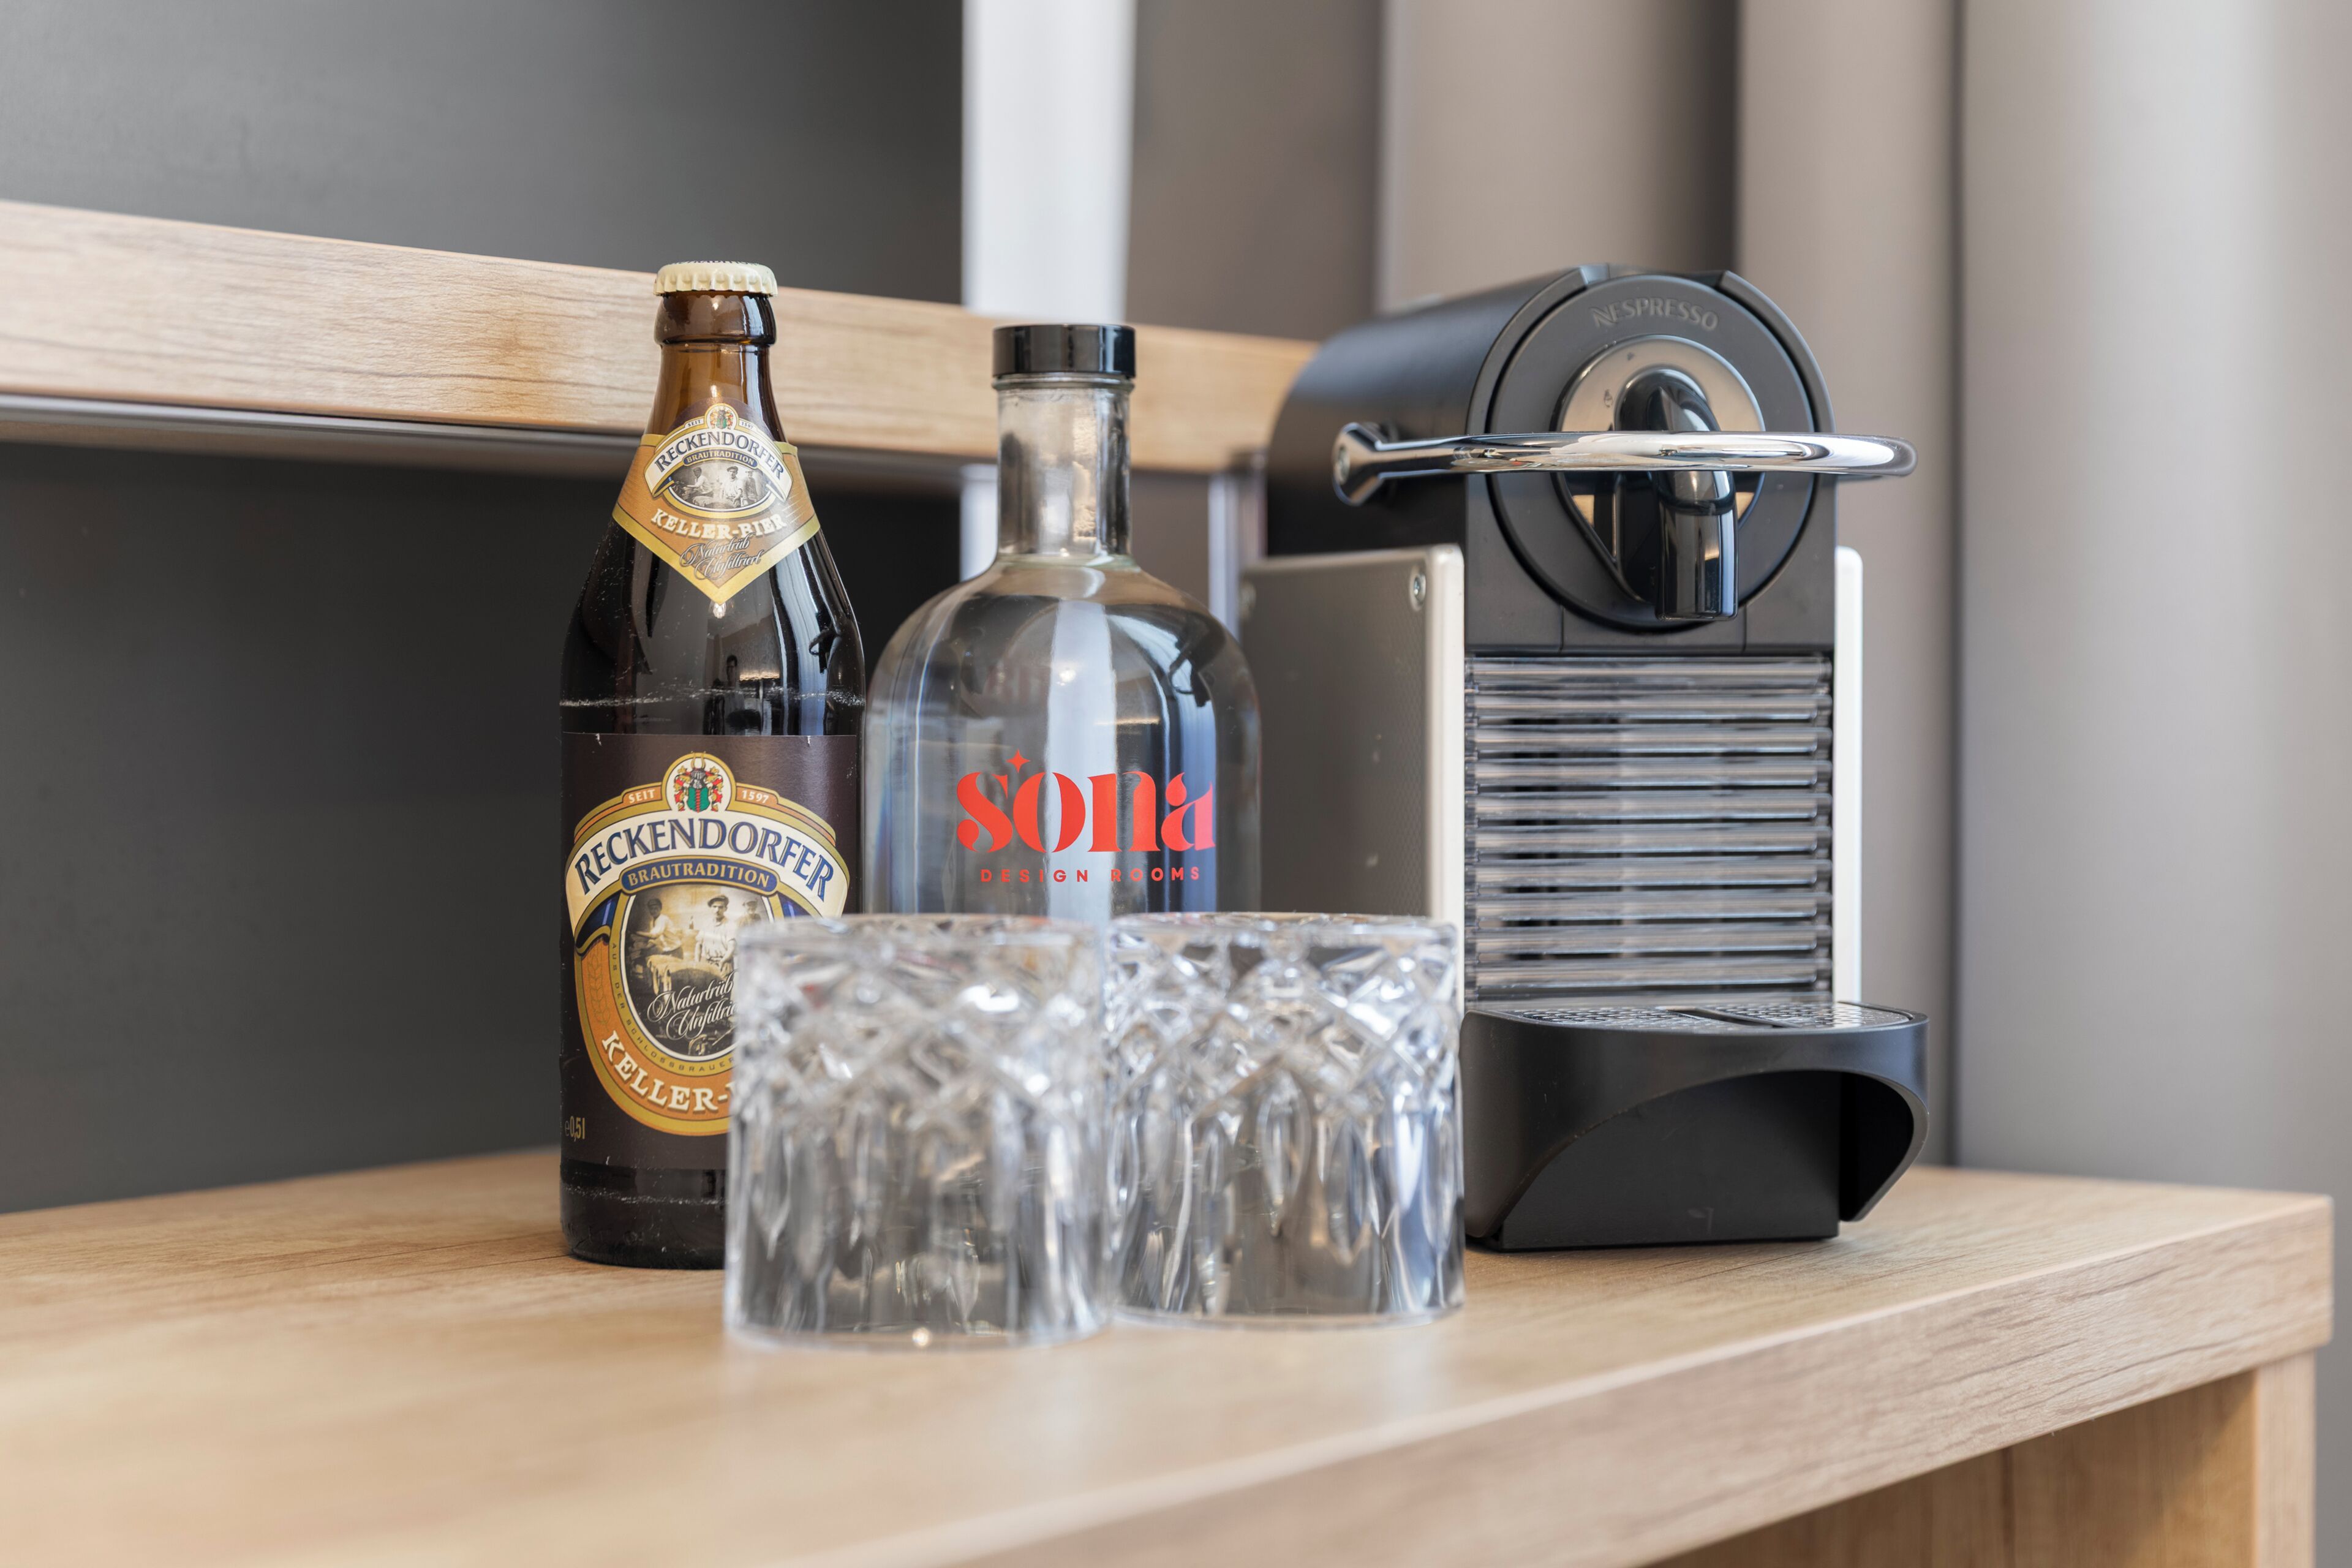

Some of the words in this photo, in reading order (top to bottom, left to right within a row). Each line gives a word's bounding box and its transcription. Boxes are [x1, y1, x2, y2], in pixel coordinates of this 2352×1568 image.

[1591, 297, 1719, 331] NESPRESSO
[654, 431, 784, 480] RECKENDORFER
[686, 451, 755, 466] BRAUTRADITION
[651, 508, 788, 540] KELLER-BIER
[680, 532, 755, 568] Naturtrüb
[695, 550, 764, 580] Unfiltriert
[628, 789, 655, 804] SEIT
[741, 790, 769, 804] 1597
[957, 771, 1216, 853] sona
[575, 818, 834, 902] RECKENDORFER
[628, 862, 770, 888] BRAUTRADITION
[980, 869, 1089, 883] DESIGN
[1110, 867, 1200, 882] ROOMS
[615, 982, 625, 1009] DER
[647, 970, 736, 1022] Naturtrüb
[601, 1030, 736, 1112] KELLER-
